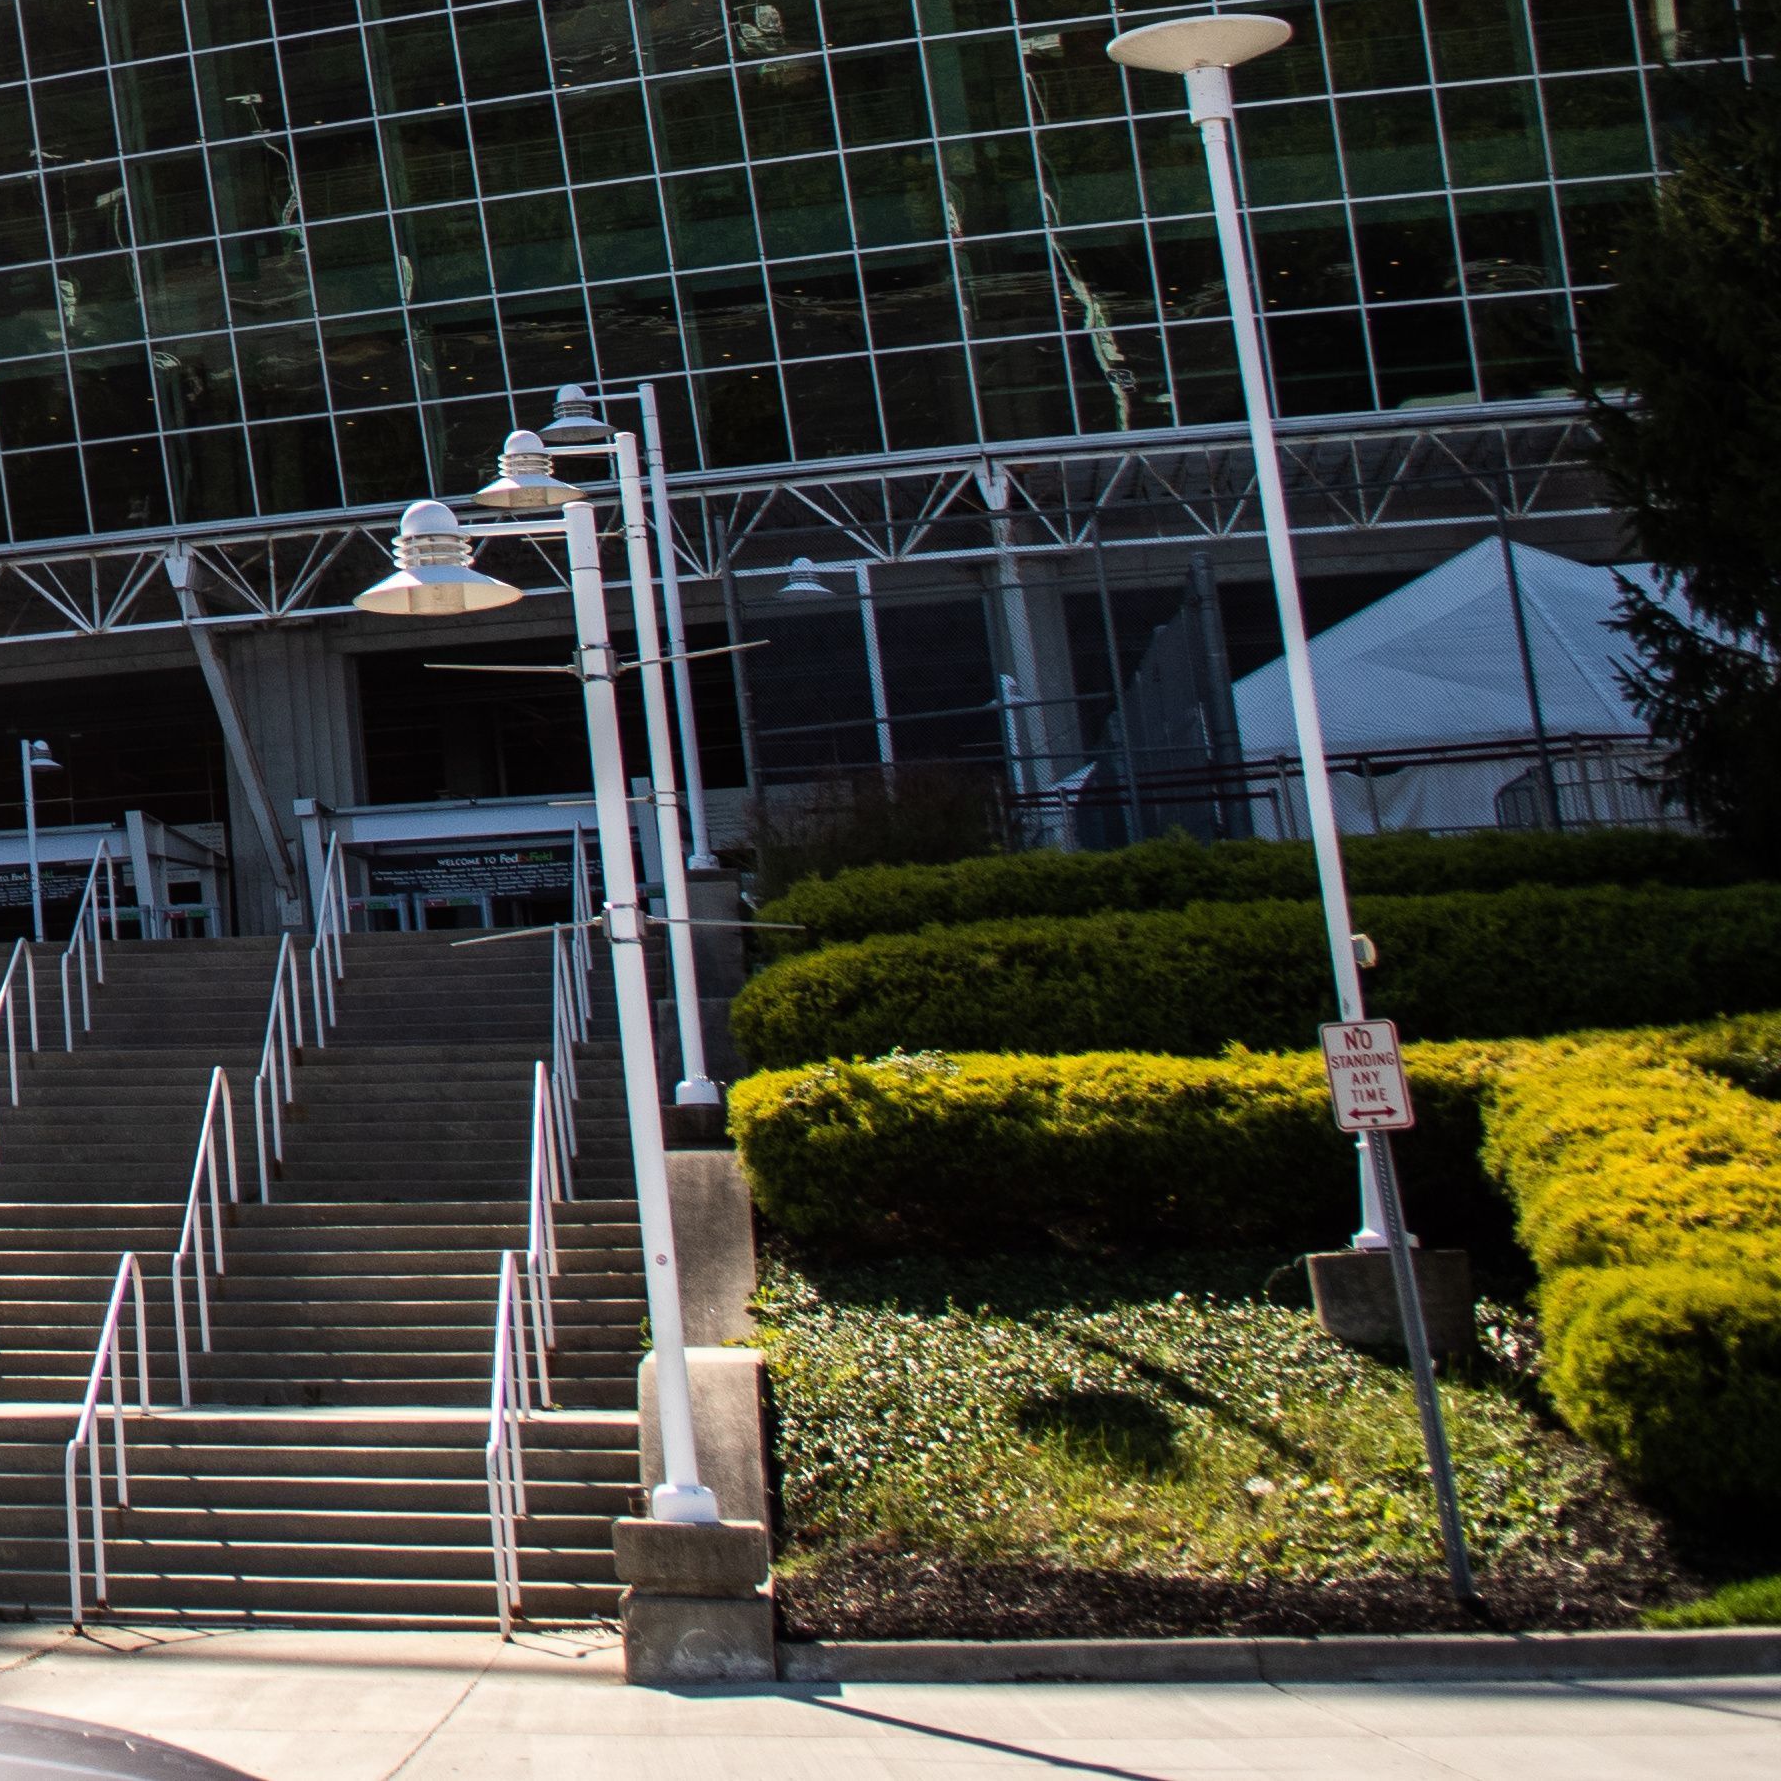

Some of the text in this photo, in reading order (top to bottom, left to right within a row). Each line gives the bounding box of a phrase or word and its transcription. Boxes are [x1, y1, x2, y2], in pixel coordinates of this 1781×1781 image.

[1343, 1030, 1373, 1051] NO
[1330, 1052, 1396, 1070] STANDING
[1351, 1071, 1382, 1085] ANY
[1351, 1087, 1388, 1104] TIME
